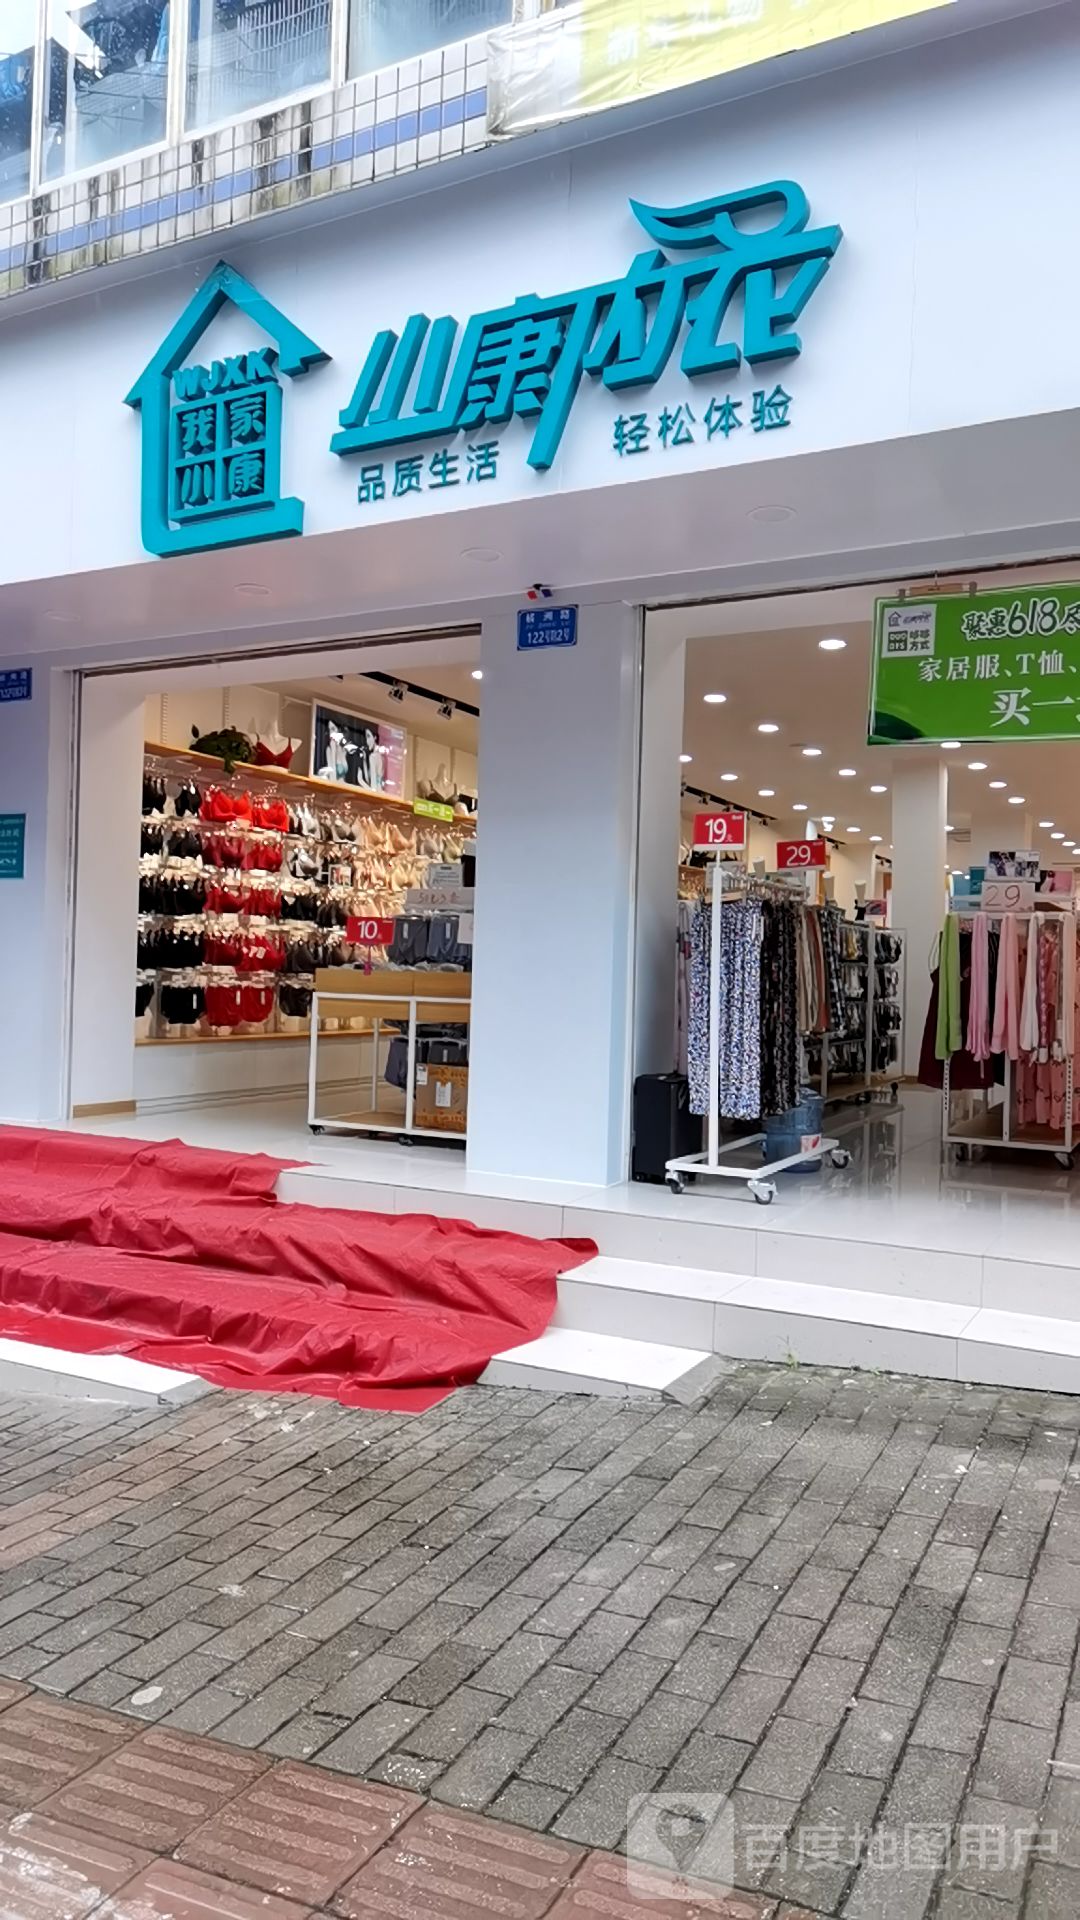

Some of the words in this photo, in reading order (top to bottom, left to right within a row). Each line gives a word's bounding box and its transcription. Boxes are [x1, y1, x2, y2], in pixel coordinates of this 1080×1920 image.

[172, 347, 280, 401] WJXK
[180, 395, 266, 452] 我家
[612, 385, 794, 458] 轻松体验
[356, 440, 500, 504] 品质生活
[989, 686, 1080, 728] 买一
[704, 817, 728, 843] 19
[786, 844, 812, 867] 29
[984, 884, 1021, 909] 29
[357, 920, 379, 940] 10
